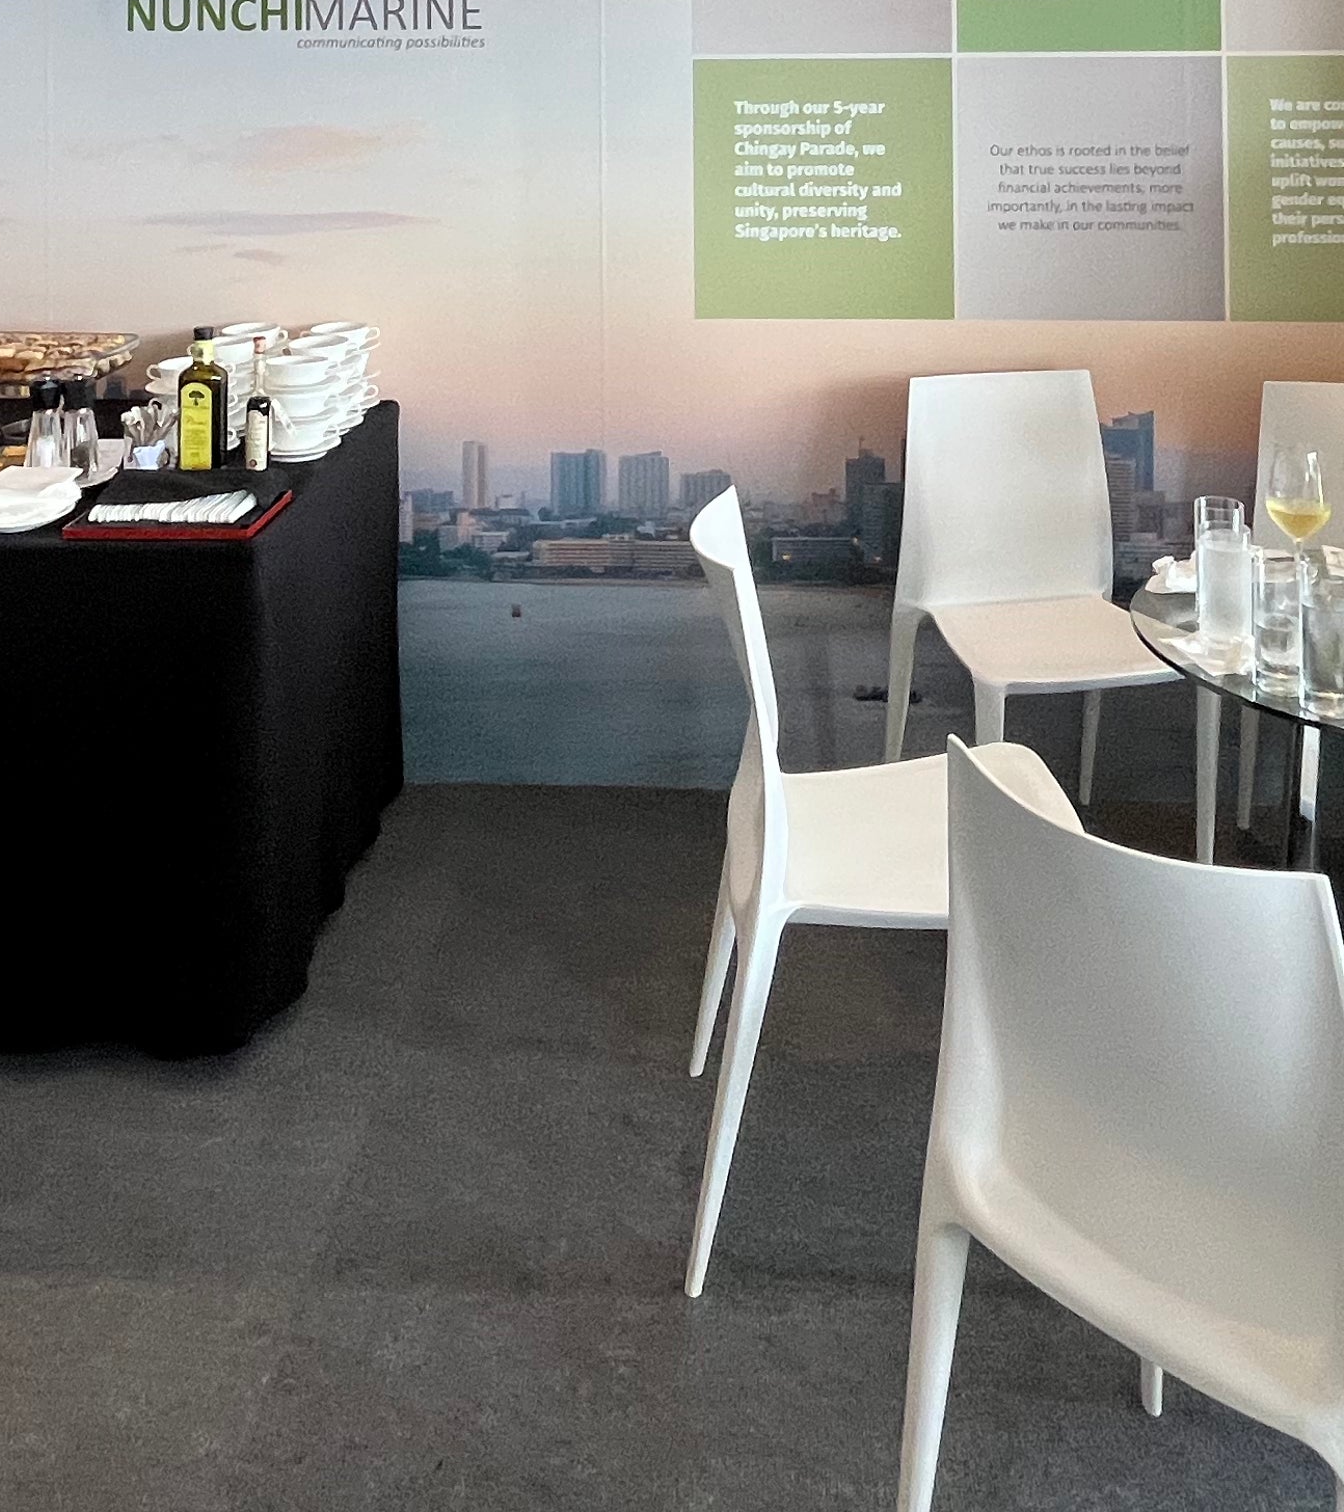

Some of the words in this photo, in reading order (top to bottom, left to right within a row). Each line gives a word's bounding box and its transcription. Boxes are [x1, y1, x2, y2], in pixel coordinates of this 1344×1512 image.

[297, 36, 402, 50] communicating
[406, 36, 485, 50] possibilities
[734, 100, 799, 118] Through
[803, 103, 829, 114] our
[834, 101, 885, 117] 5-year
[1270, 98, 1292, 111] We
[1296, 100, 1320, 111] are
[734, 119, 831, 138] sponsorship
[835, 120, 852, 135] of
[1271, 118, 1286, 129] to
[734, 140, 796, 159] Chingay
[800, 141, 859, 157] Parade,
[863, 145, 885, 156] we
[990, 144, 1013, 157] Our
[1017, 145, 1052, 156] ethos
[1056, 146, 1065, 156] is
[1069, 145, 1111, 156] rooted
[1115, 145, 1127, 156] in
[1130, 145, 1150, 156] the
[1271, 138, 1325, 151] causes,
[1271, 154, 1344, 167] initiatives
[734, 161, 763, 176] aim
[768, 164, 783, 176] to
[787, 164, 854, 179] promote
[1000, 164, 1024, 175] that
[1029, 165, 1054, 175] true
[1059, 165, 1105, 175] success
[1109, 164, 1130, 174] lies
[1134, 164, 1181, 177] beyond
[735, 182, 795, 197] cultural
[799, 181, 868, 200] diversity
[872, 182, 901, 196] and
[998, 182, 1051, 193] financial
[1149, 183, 1183, 193] more
[734, 202, 778, 221] unity,
[783, 202, 868, 221] preserving
[1067, 202, 1077, 212] in
[1082, 201, 1103, 212] the
[1106, 200, 1147, 214] lasting
[1152, 202, 1193, 213] impact
[831, 223, 902, 241] heritage.
[998, 222, 1016, 230] we
[1020, 220, 1053, 230] make
[1058, 220, 1069, 230] in
[1073, 222, 1094, 230] our
